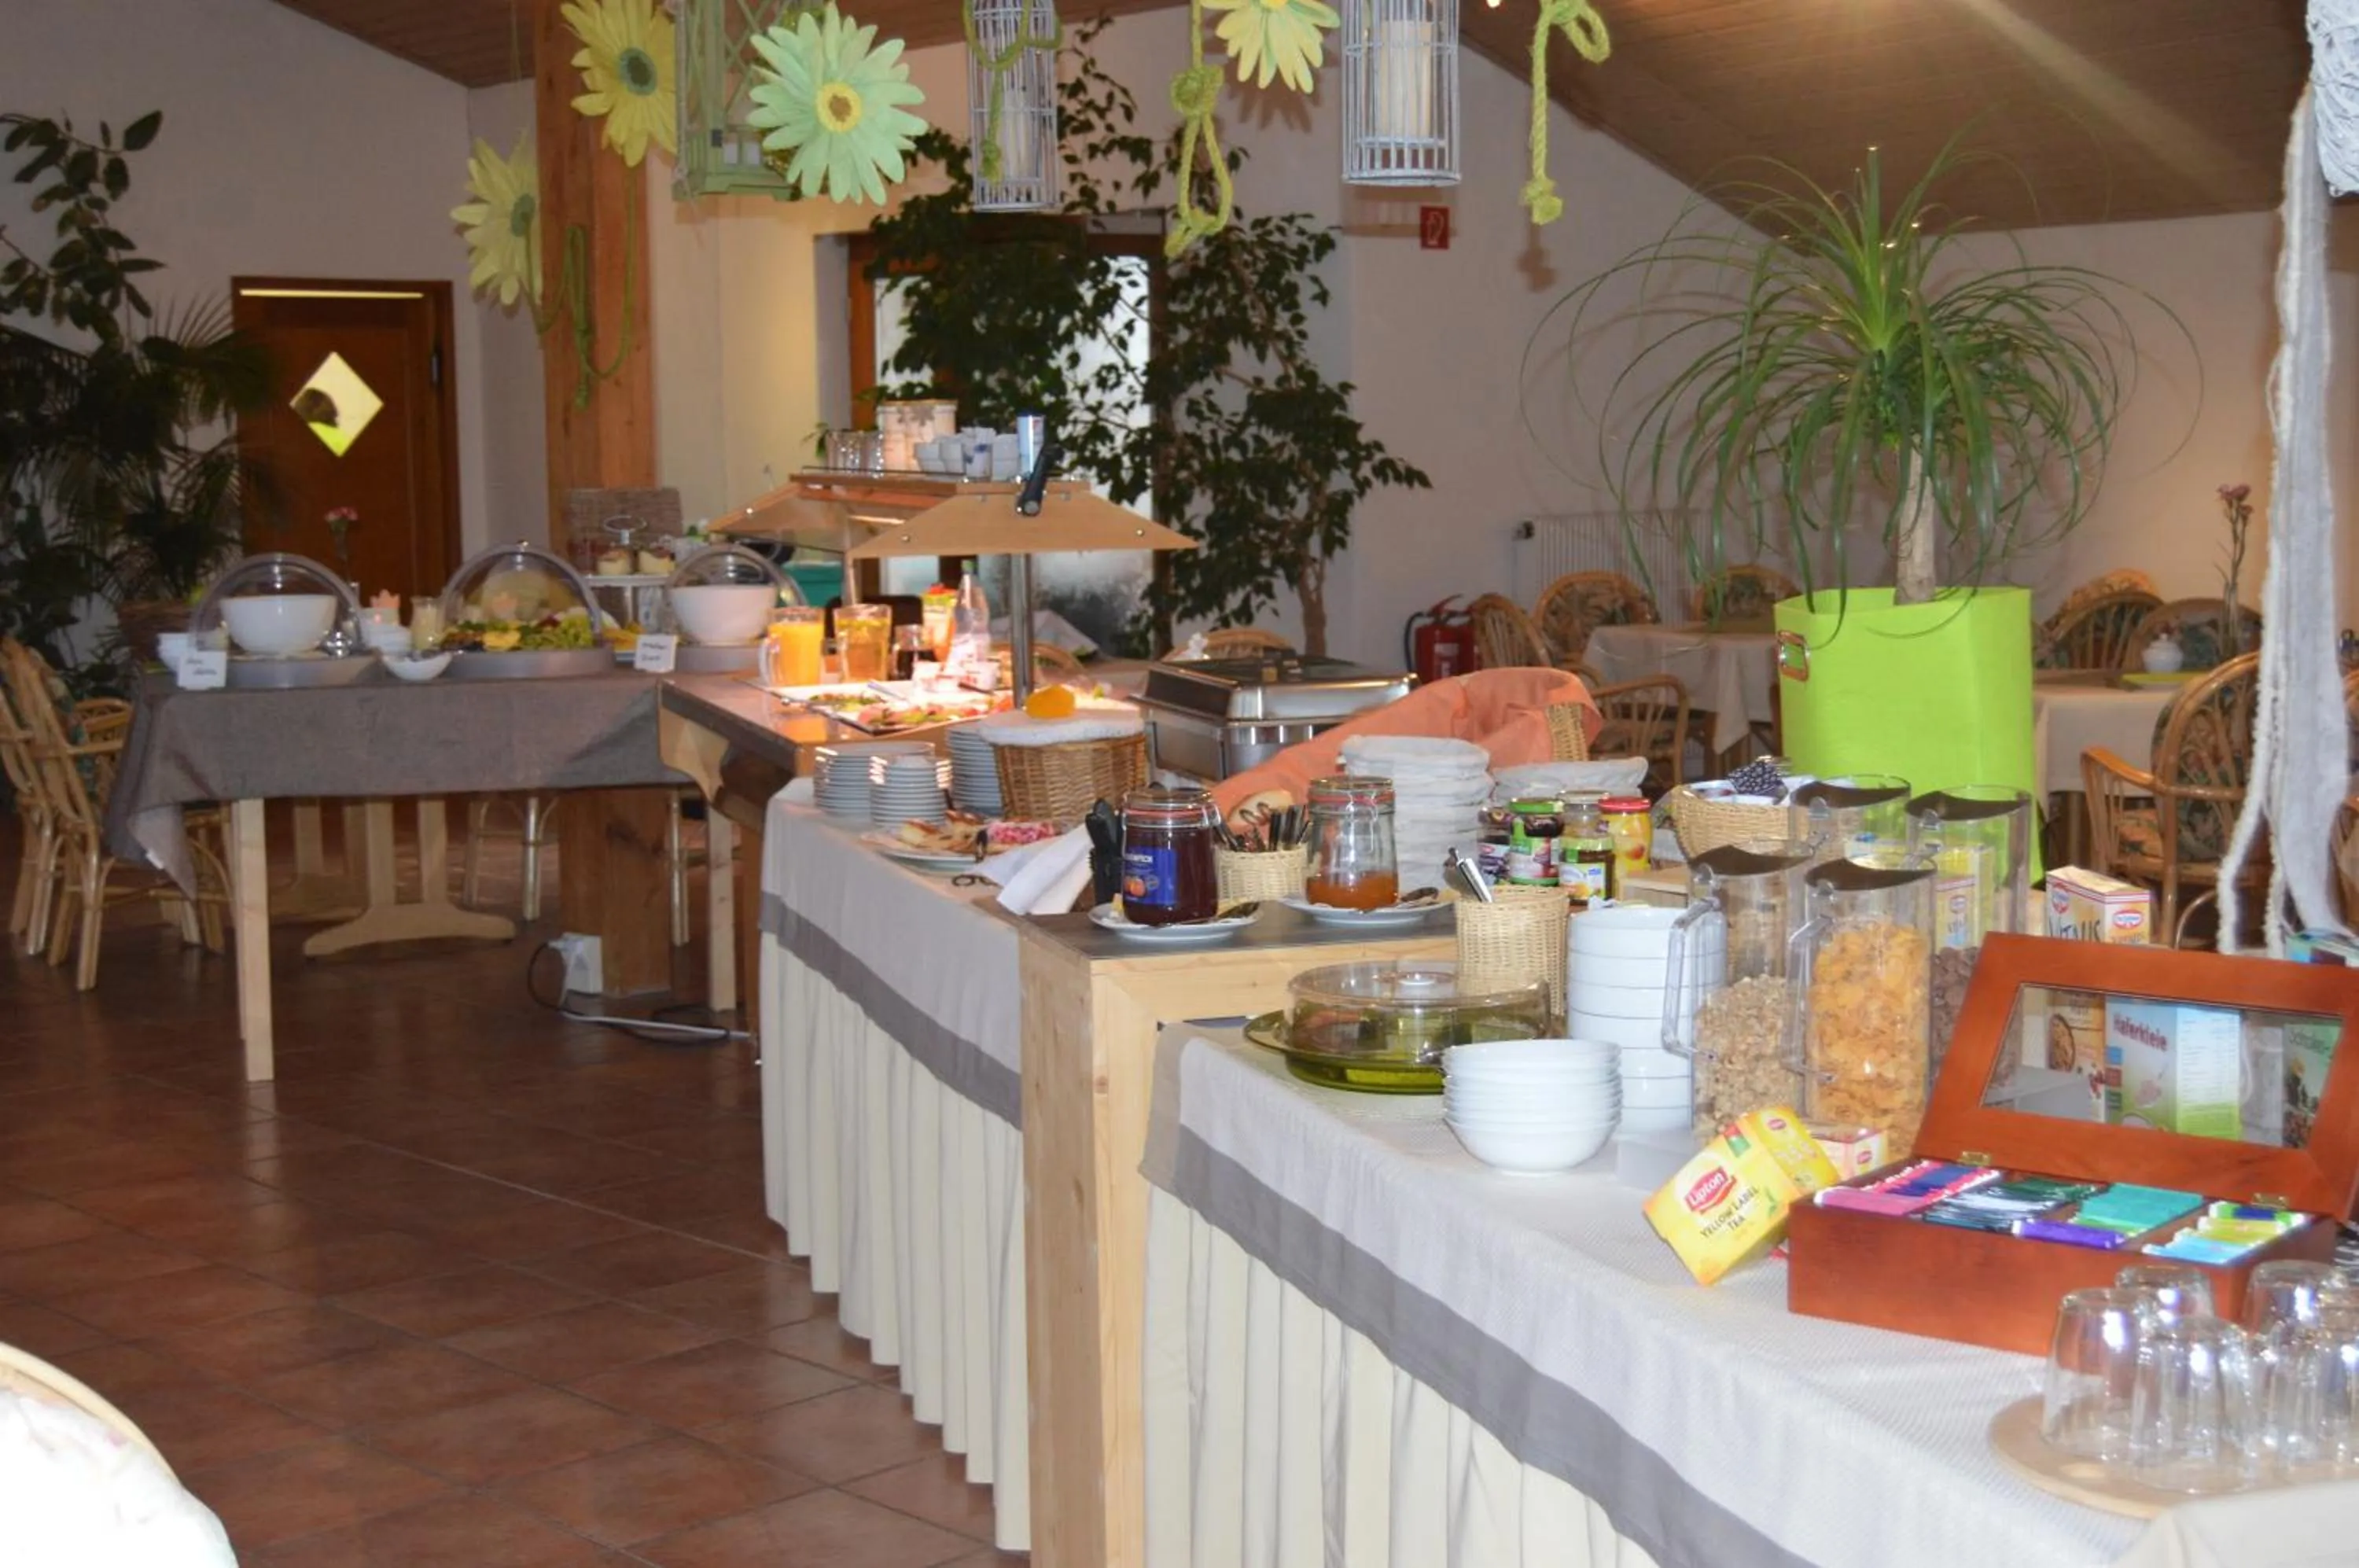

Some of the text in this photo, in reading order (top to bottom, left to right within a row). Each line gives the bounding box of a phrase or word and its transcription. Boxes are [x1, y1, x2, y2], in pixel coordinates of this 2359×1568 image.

[1688, 1171, 1726, 1206] Lipton
[1699, 1185, 1760, 1239] YELLOW LABEL
[1728, 1215, 1746, 1231] TEA
